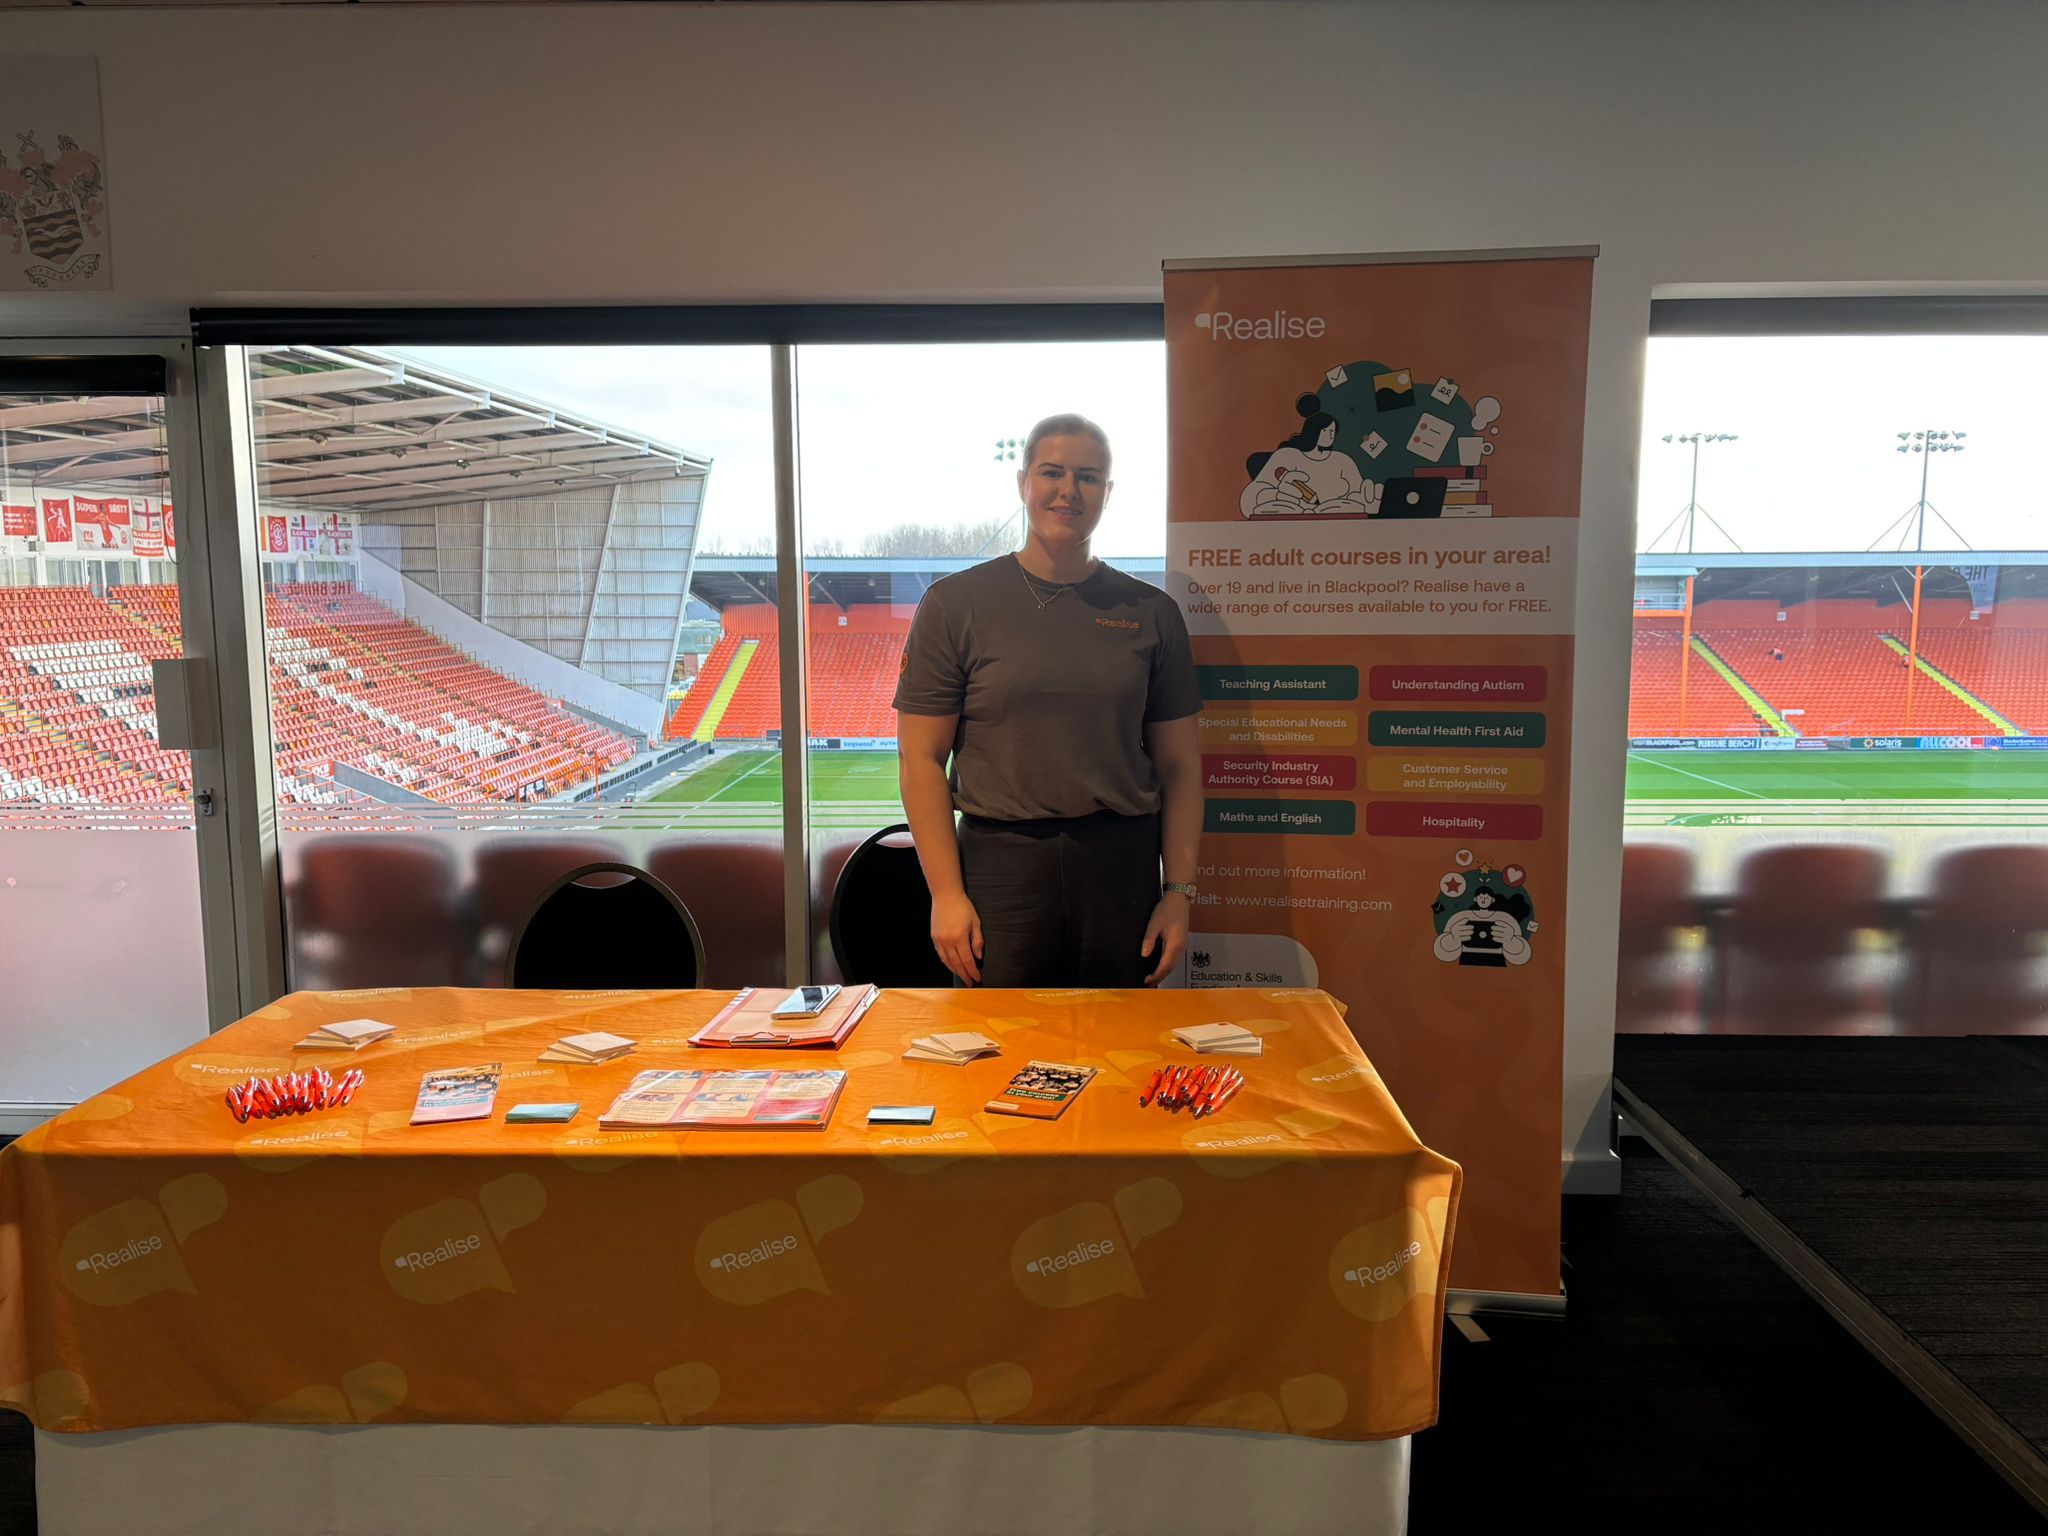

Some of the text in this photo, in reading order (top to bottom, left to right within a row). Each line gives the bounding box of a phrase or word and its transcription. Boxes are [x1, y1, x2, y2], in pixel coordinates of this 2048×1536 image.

[1212, 311, 1325, 341] Realise
[1188, 546, 1551, 569] FREE adult courses in your area!
[1187, 580, 1525, 596] Over 19 and live in Blackpool? Realise have a
[1187, 599, 1552, 617] wide range of courses available to you for FREE.
[1220, 678, 1326, 693] Teaching Assistant
[1392, 679, 1524, 693] Understanding Autism
[1198, 716, 1347, 730] Special Educational Needs
[1229, 731, 1315, 742] and Disabilities
[1390, 725, 1523, 737] Mental Health First Aid
[1223, 760, 1319, 773] Security Industry
[1402, 763, 1508, 776] Customer Service
[1208, 773, 1334, 788] Authority Course (SIA)
[1403, 778, 1507, 792] and Employability
[1220, 811, 1322, 825] Maths and English
[1422, 816, 1485, 830] Hospitality
[1197, 865, 1366, 880] nd out more information!
[1226, 896, 1392, 912] www.realisetraining.com
[1191, 971, 1282, 983] Education & Skills
[201, 1063, 280, 1076] Realise
[501, 1066, 556, 1081] ealise
[265, 1128, 348, 1147] Realise
[892, 1129, 968, 1149] Realise
[1208, 1132, 1282, 1150] Realise
[90, 1232, 162, 1275] Realise
[407, 1231, 480, 1273] Realise
[724, 1233, 798, 1274] Realise
[1037, 1236, 1115, 1279] Realise
[1357, 1237, 1422, 1290] Realise
